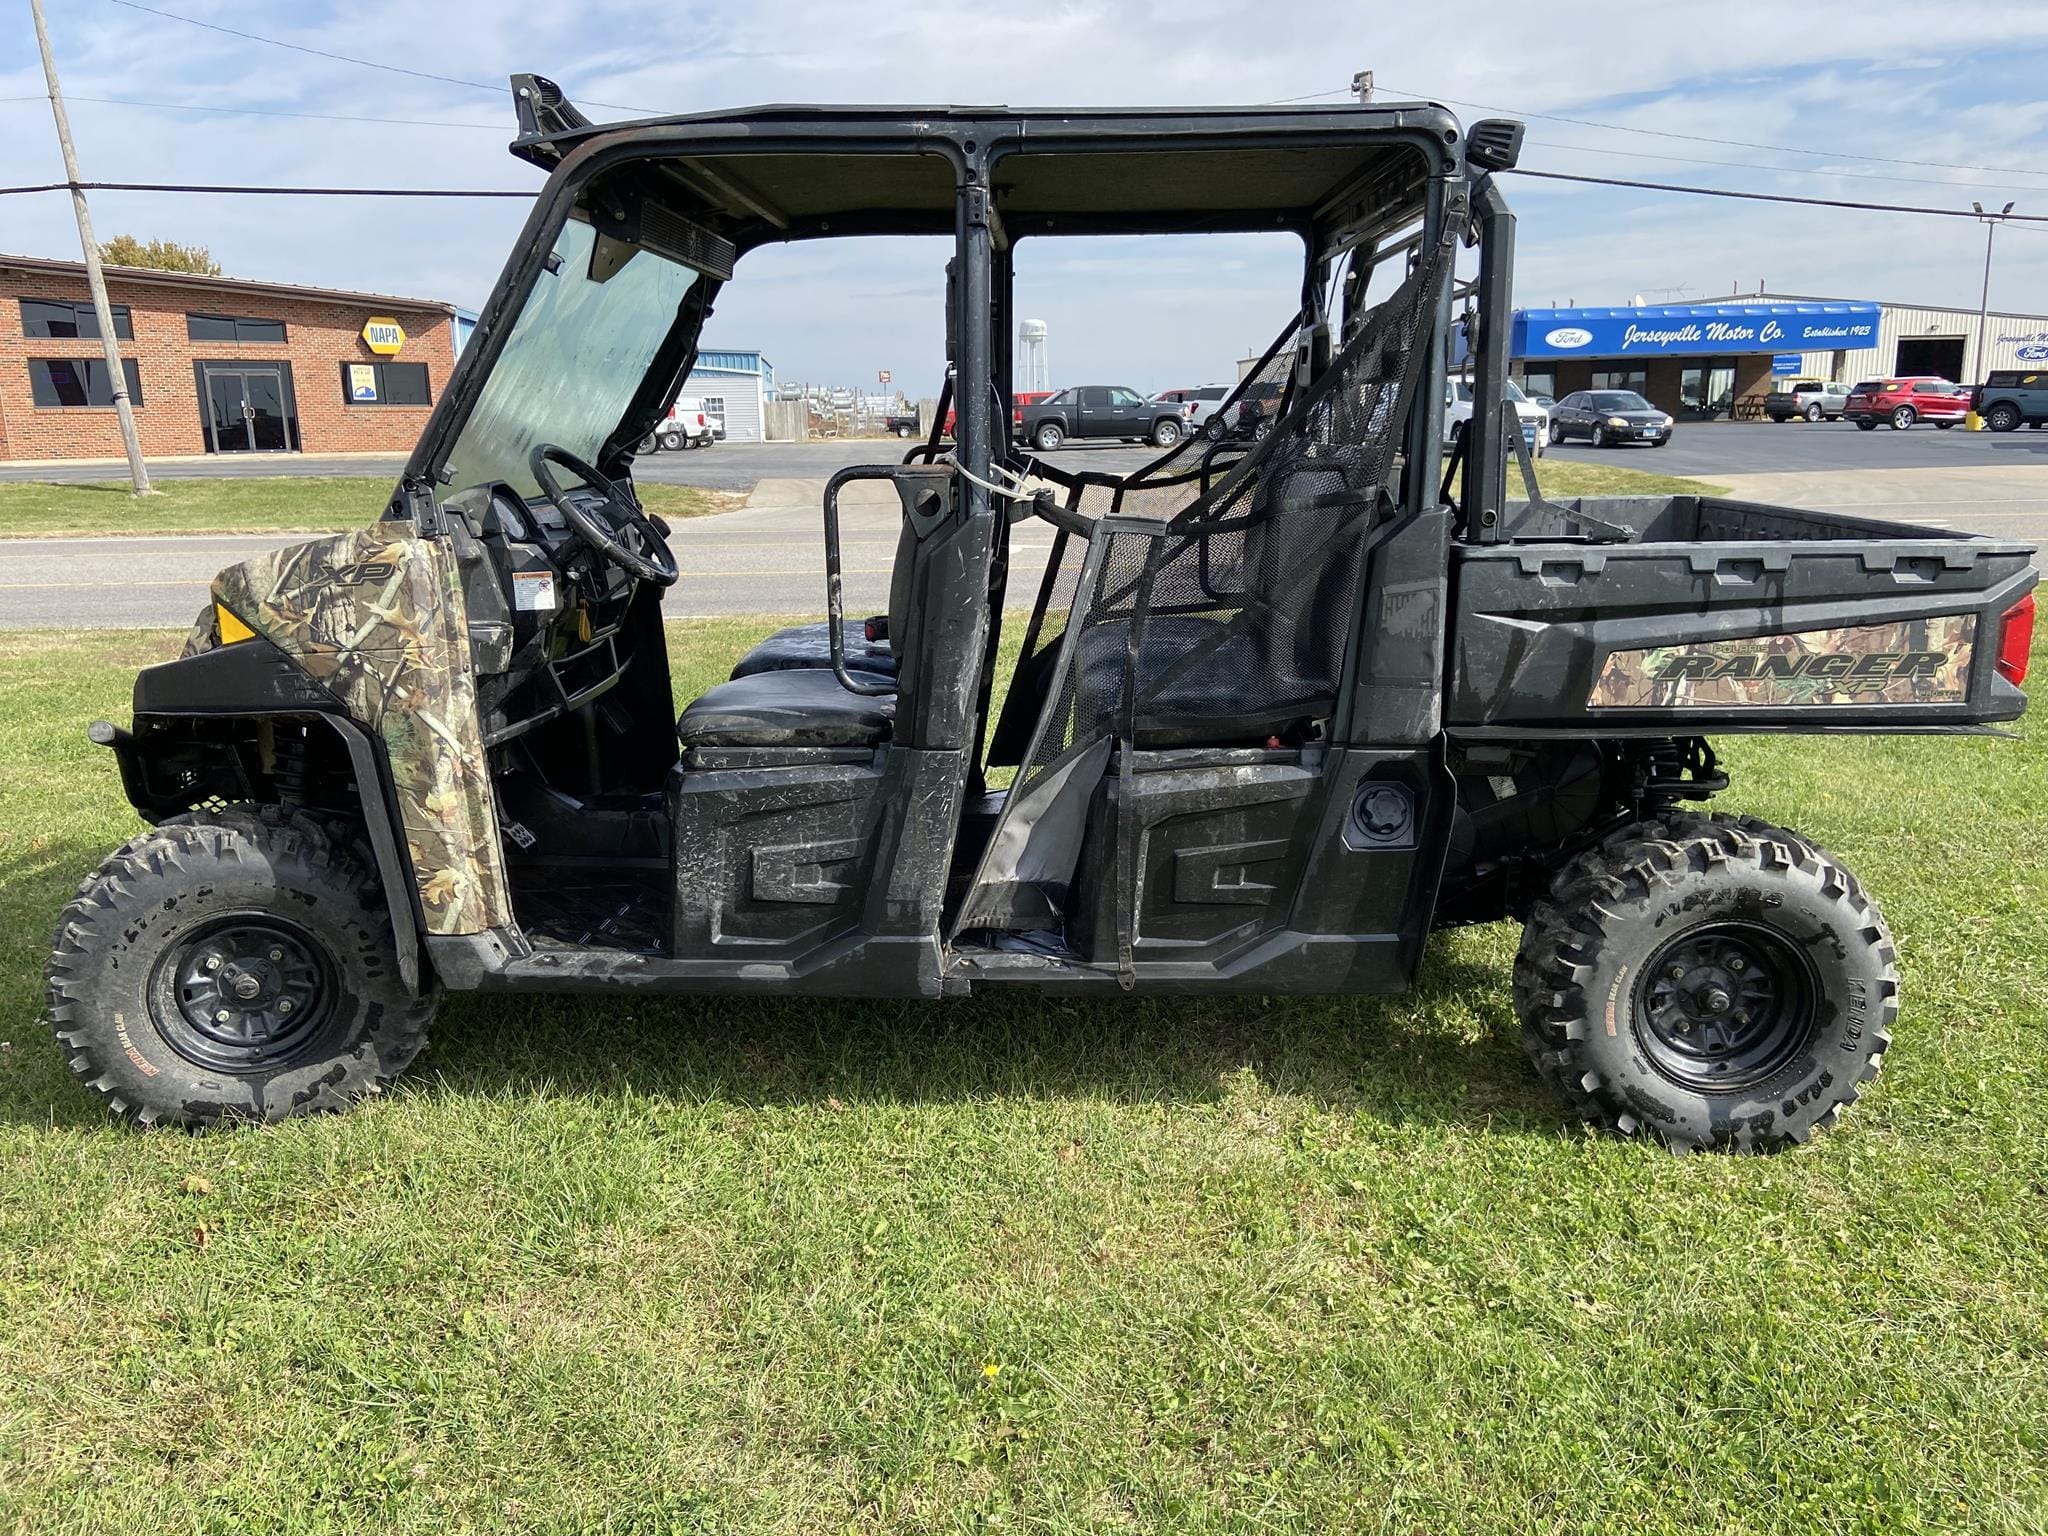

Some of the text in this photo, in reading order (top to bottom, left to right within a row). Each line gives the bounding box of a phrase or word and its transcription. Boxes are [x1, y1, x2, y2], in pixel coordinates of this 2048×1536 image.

[370, 326, 399, 344] NAPA
[1554, 331, 1583, 344] Ford
[1622, 320, 1785, 350] Jerseyville Motor Co.
[1803, 325, 1871, 338] Established 1923
[302, 562, 395, 586] XP
[1712, 644, 1769, 654] POLARIS
[1657, 652, 1949, 680] RANGER
[1818, 680, 1887, 695] XP
[1840, 977, 1867, 1052] KENDA
[125, 1046, 160, 1077] KENDA
